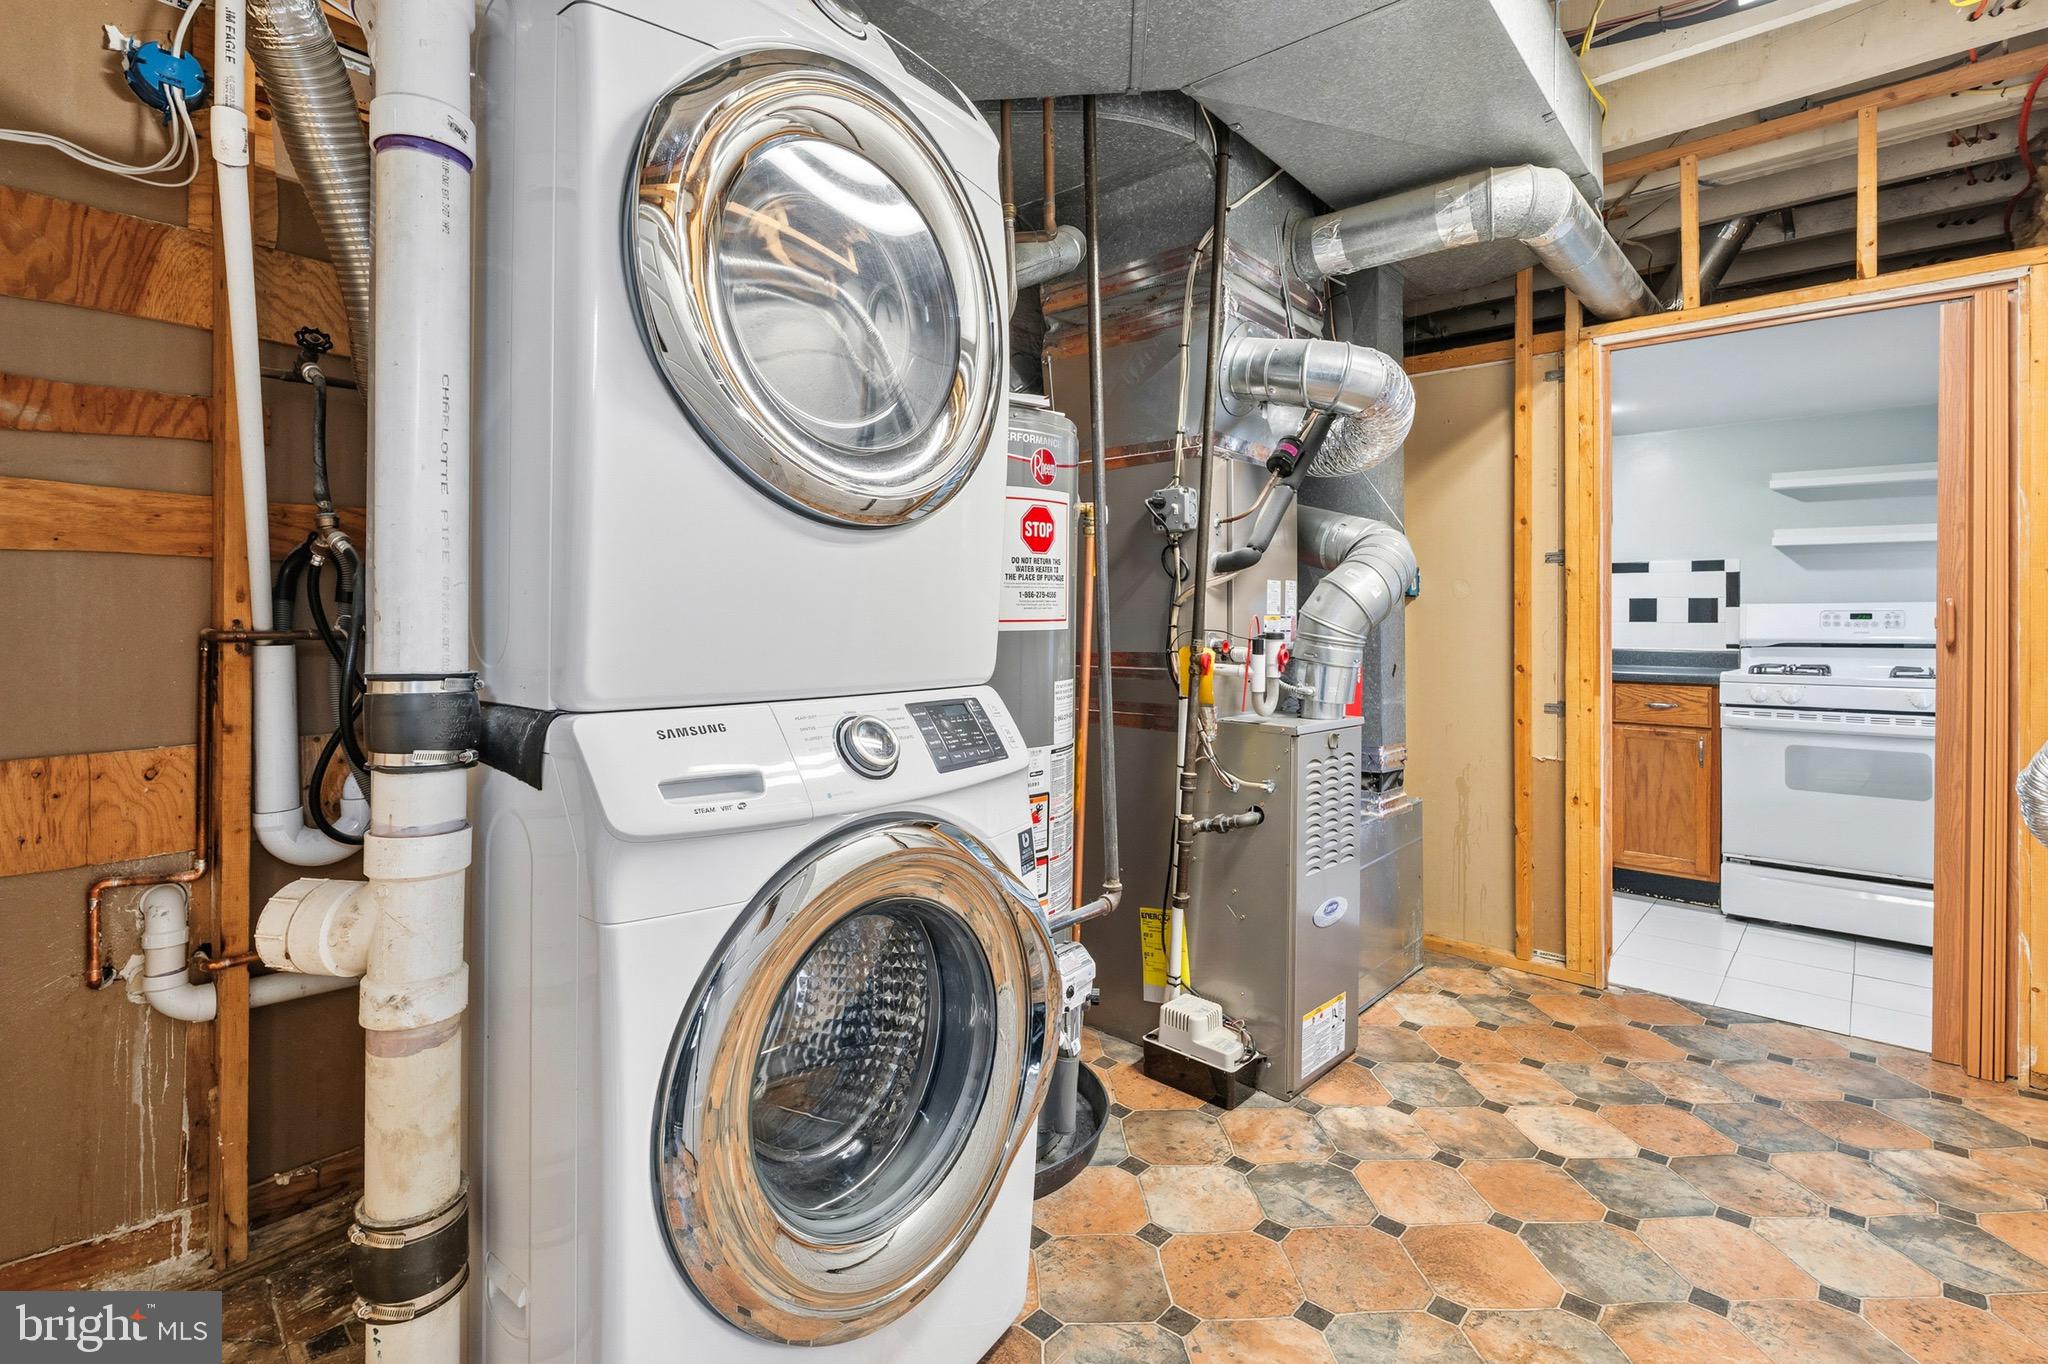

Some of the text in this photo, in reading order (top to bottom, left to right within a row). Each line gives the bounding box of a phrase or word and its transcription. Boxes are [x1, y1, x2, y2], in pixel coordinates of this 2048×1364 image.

[225, 25, 236, 64] EAGLE
[440, 373, 450, 495] CHARLOTTE
[1034, 449, 1056, 479] Rheem
[1024, 521, 1053, 538] STOP
[1011, 556, 1020, 564] DO
[1004, 573, 1017, 581] THE
[1018, 573, 1035, 581] PLACE
[1015, 565, 1034, 573] WATER
[656, 723, 727, 740] SAMSUNG
[693, 807, 715, 815] STEAM
